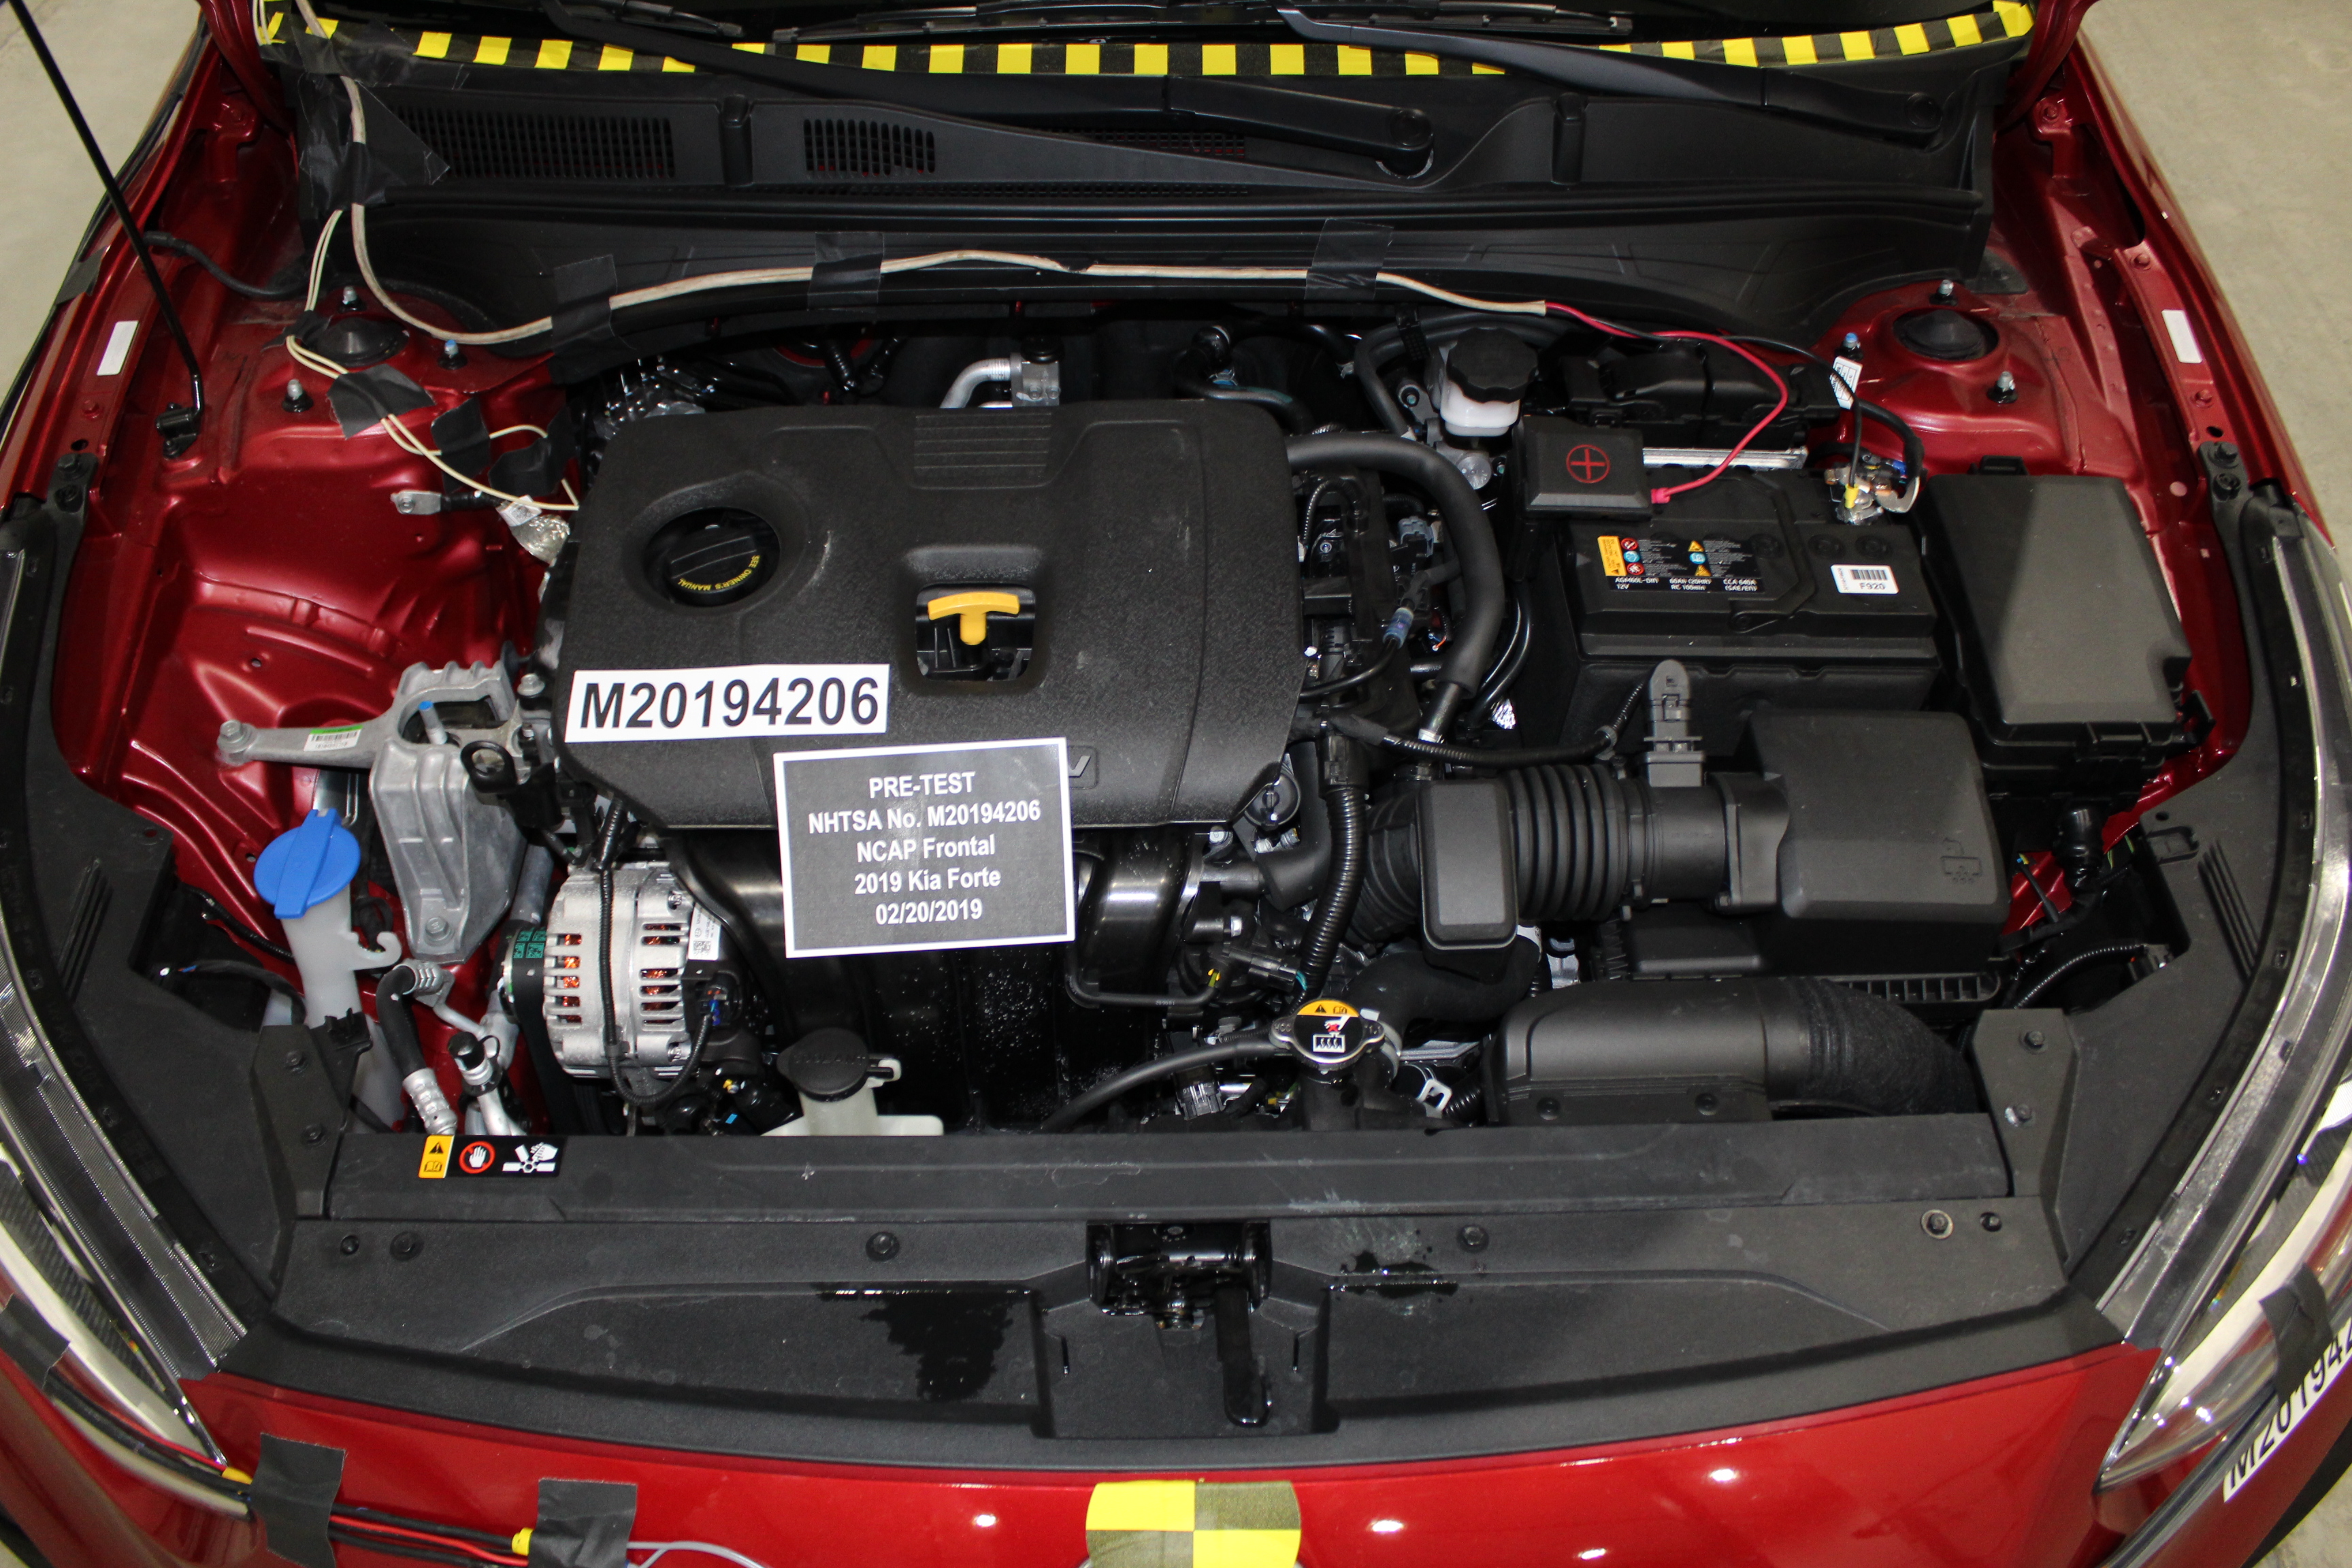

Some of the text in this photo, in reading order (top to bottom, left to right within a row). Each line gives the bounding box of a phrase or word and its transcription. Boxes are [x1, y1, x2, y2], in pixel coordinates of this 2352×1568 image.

[678, 555, 760, 591] SEE OWNER'S MANUAL
[580, 677, 879, 729] M20194206
[869, 771, 976, 799] PRE-TEST
[808, 799, 1041, 834] NHTSA No. M20194206
[857, 834, 996, 863] NCAP Frontal
[854, 866, 1002, 894] 2019 Kia Forte
[875, 898, 983, 926] 02/20/2019
